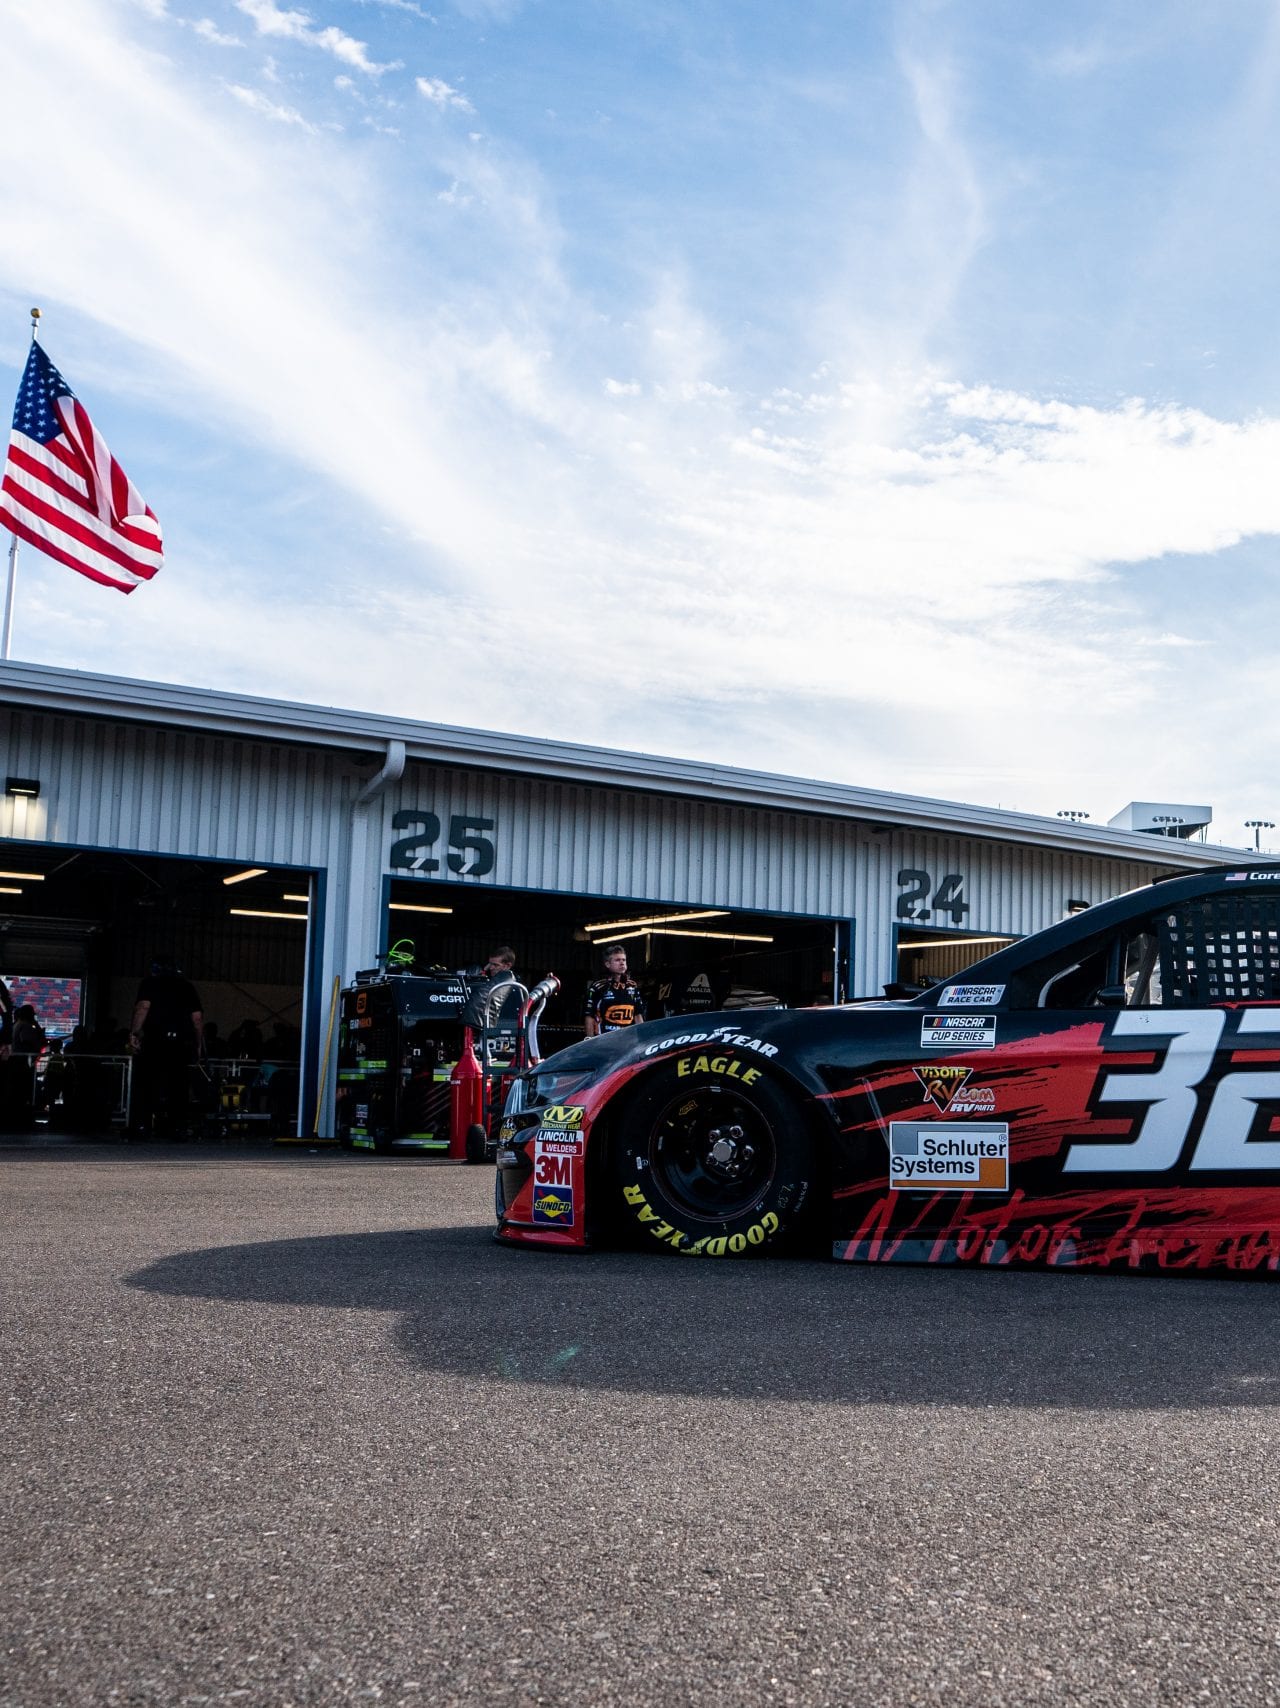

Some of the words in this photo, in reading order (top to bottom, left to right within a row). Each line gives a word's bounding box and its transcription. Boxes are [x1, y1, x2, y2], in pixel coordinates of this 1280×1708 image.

[390, 809, 494, 876] 25
[897, 869, 969, 922] 24
[960, 987, 996, 995] NASCAR
[945, 1017, 986, 1028] NASCAR
[931, 1031, 951, 1041] CUP
[951, 1031, 986, 1041] SERIES
[677, 1055, 763, 1086] EAGLE
[950, 1103, 976, 1112] RV
[538, 1130, 576, 1142] LINCOLN
[545, 1144, 577, 1153] WELDERS
[923, 1139, 1006, 1156] Schluter
[536, 1155, 571, 1185] 3M
[891, 1157, 975, 1177] Systems
[535, 1200, 571, 1213] SUNOCO
